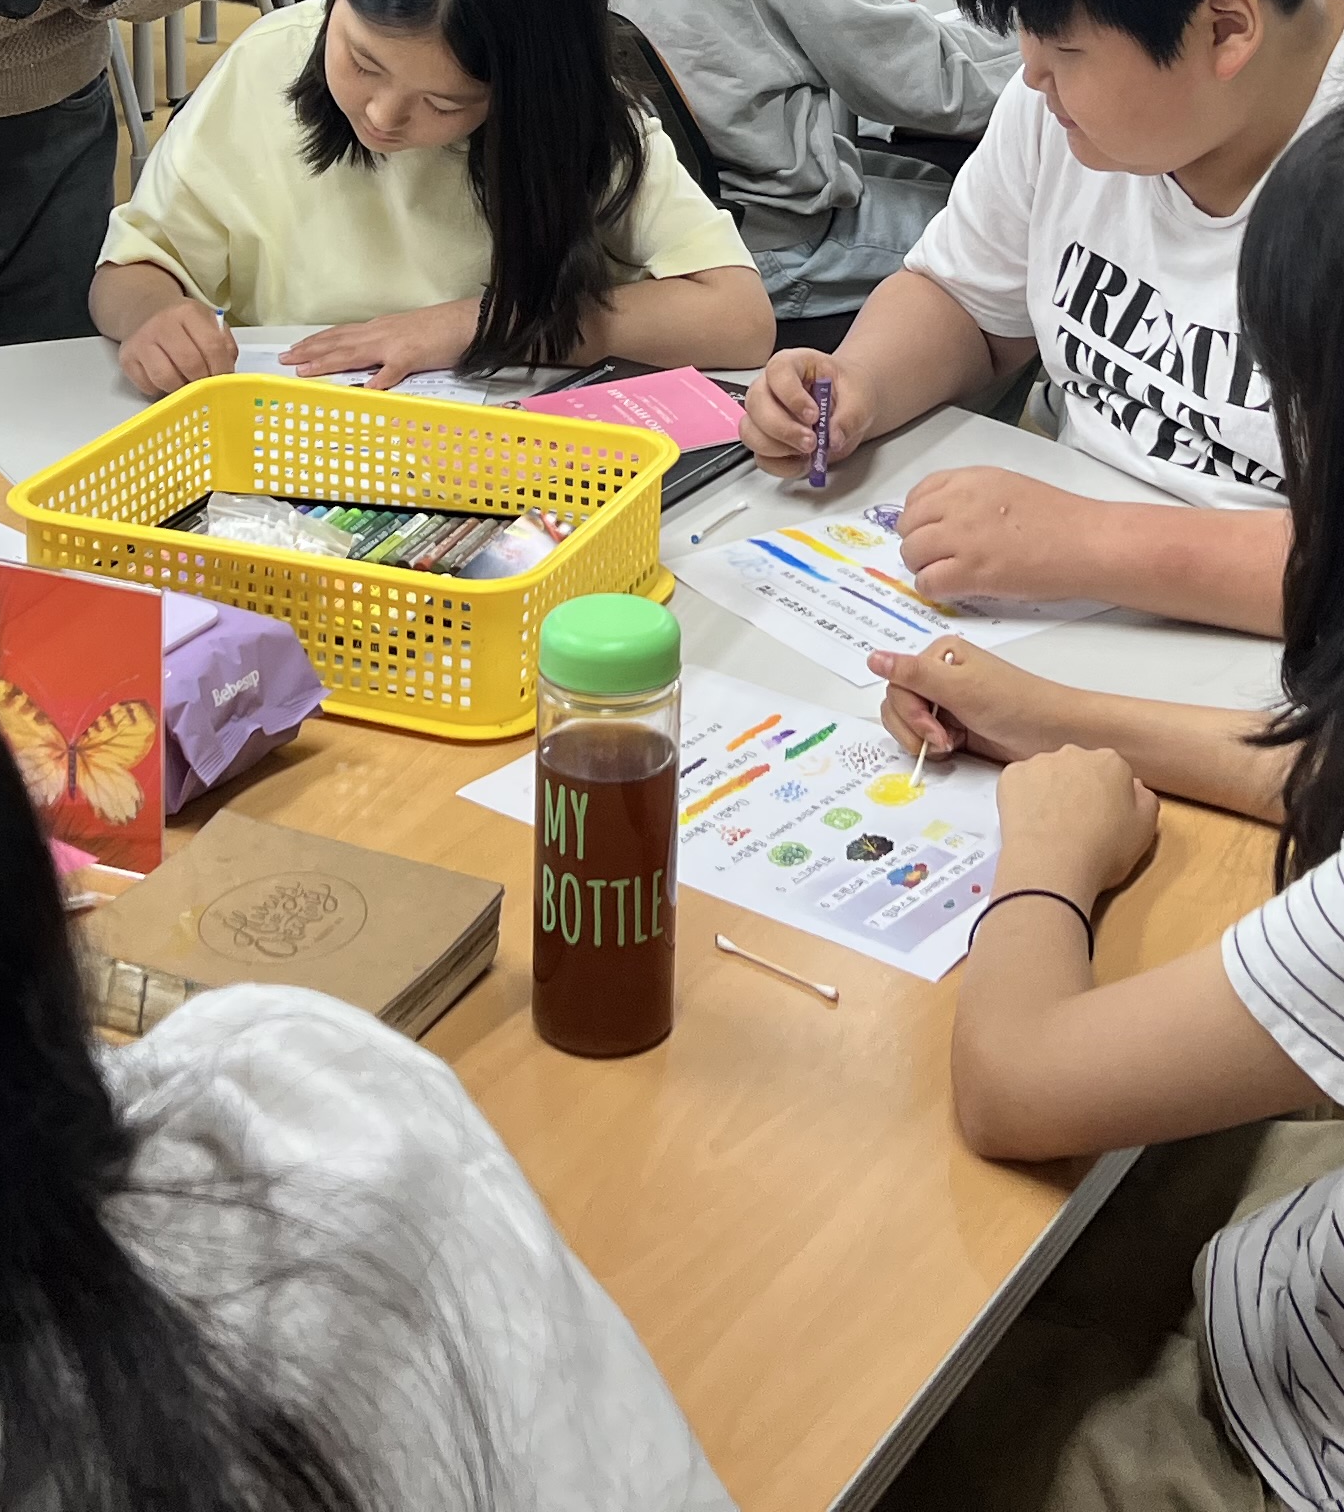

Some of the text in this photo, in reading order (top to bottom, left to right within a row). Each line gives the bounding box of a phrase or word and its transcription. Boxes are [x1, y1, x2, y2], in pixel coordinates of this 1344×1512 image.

[819, 398, 827, 427] PASTEL
[543, 779, 589, 860] MY
[542, 863, 664, 948] BOTTLE
